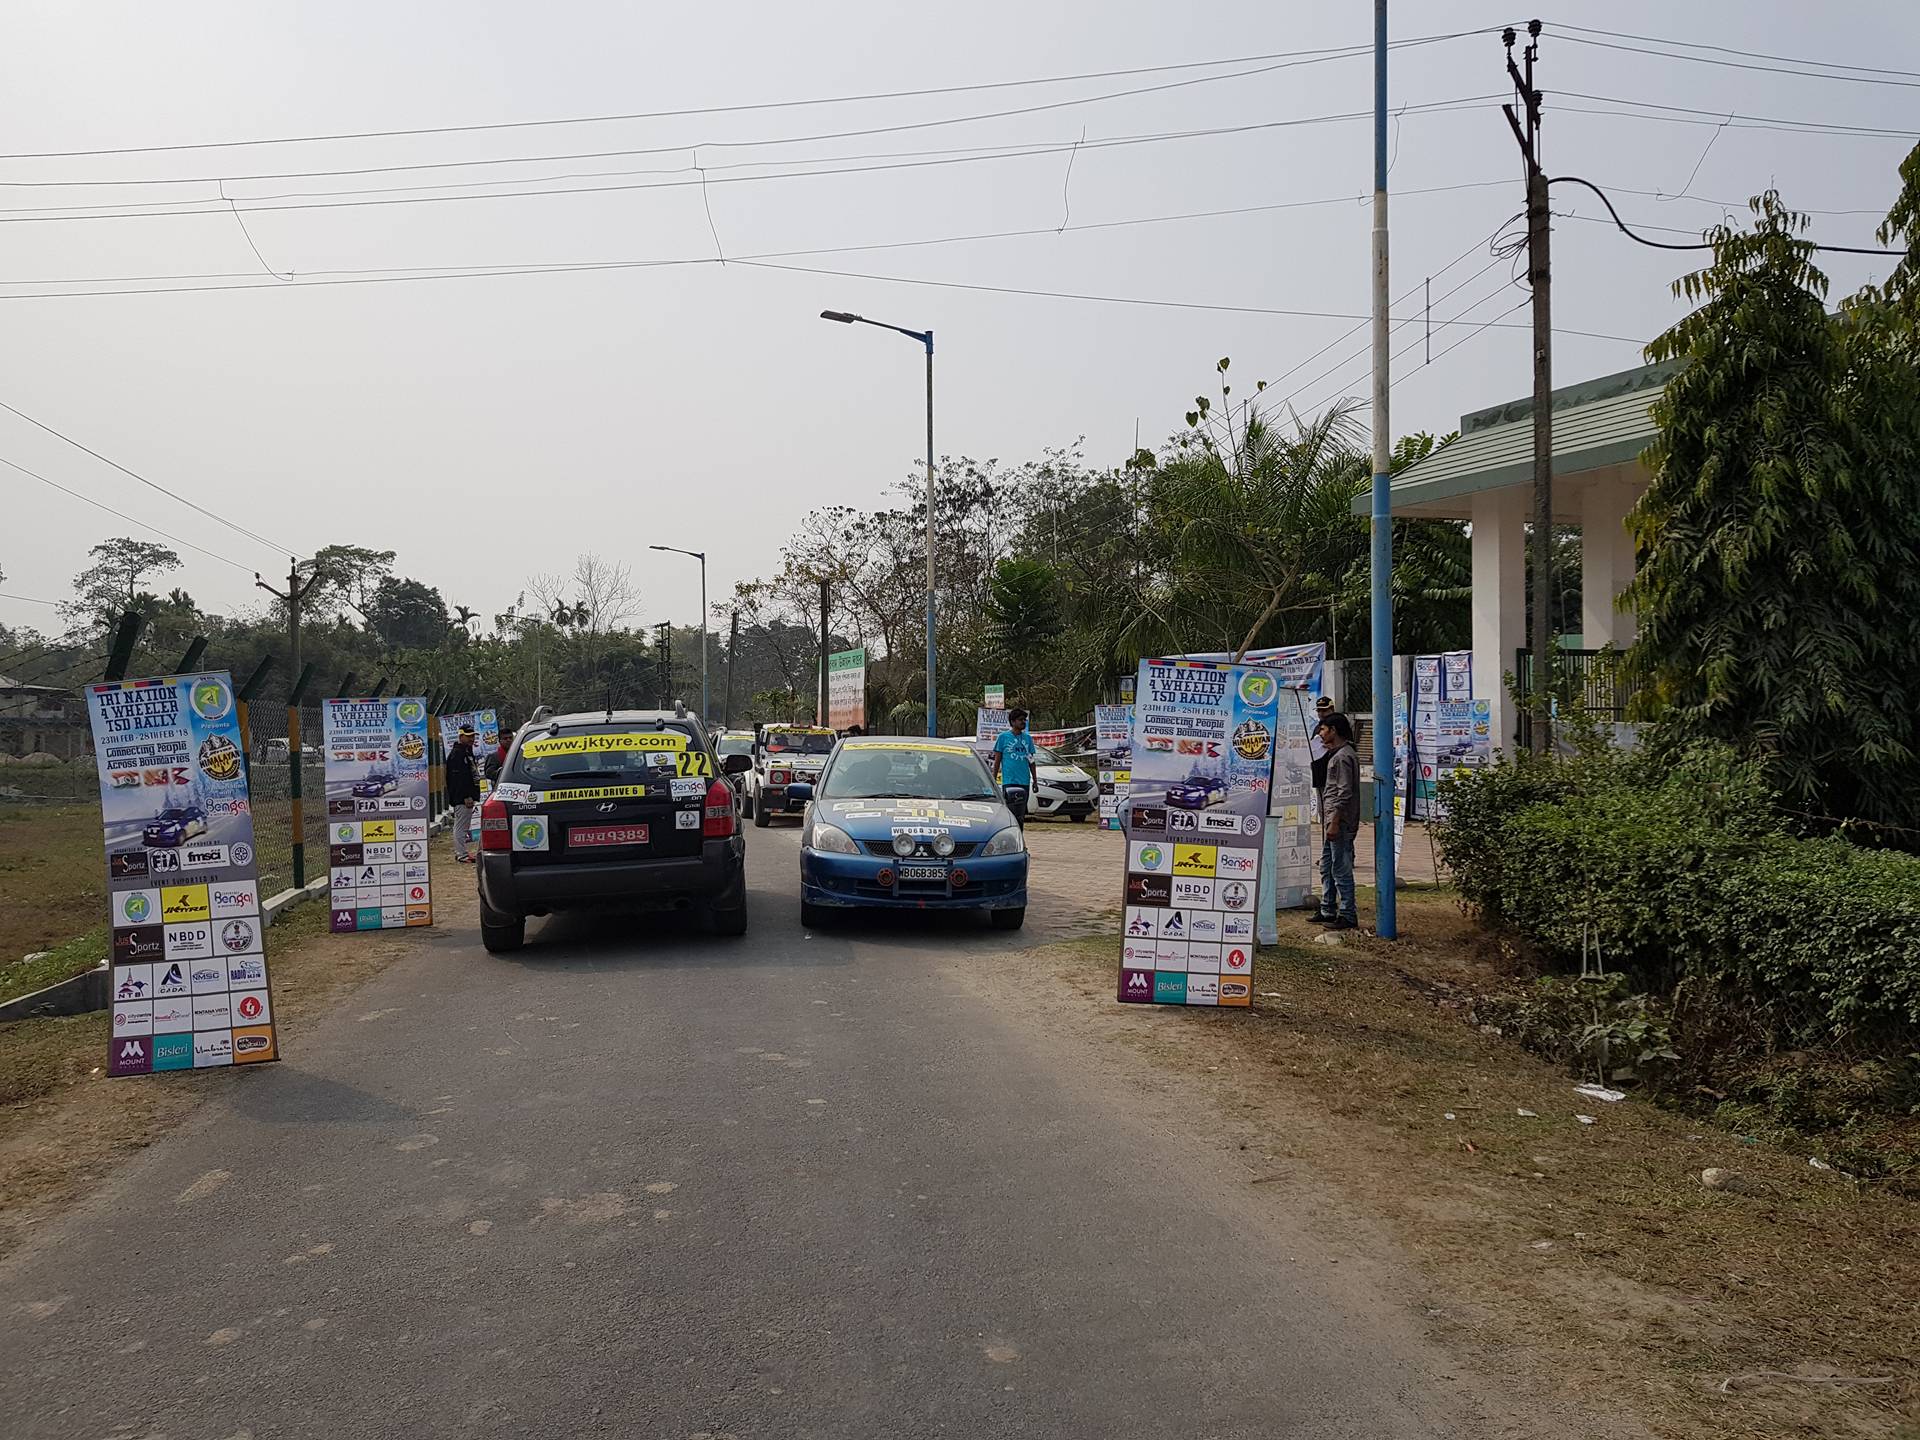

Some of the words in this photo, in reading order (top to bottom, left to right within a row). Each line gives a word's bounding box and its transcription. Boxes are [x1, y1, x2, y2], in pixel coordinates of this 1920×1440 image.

[1150, 667, 1172, 679] TRI
[1176, 669, 1229, 683] NATION
[1161, 680, 1225, 694] WHEELER
[97, 693, 120, 706] TRI
[123, 687, 178, 704] NATION
[1152, 691, 1176, 703] TSD
[1179, 692, 1222, 705] RALLY
[111, 700, 179, 718] WHEELER
[351, 703, 388, 712] NATION
[1202, 708, 1215, 716] FEB
[106, 719, 130, 732] TSD
[133, 713, 177, 730] RALLY
[340, 712, 388, 720] WHEELER
[355, 719, 386, 728] RALLY
[1146, 714, 1194, 728] Connecting
[1196, 718, 1225, 730] People
[120, 734, 134, 742] FEB
[159, 730, 174, 739] FEB
[1143, 725, 1174, 736] Across
[1176, 728, 1225, 739] Boundaries
[106, 744, 155, 758] Connecting
[156, 741, 187, 754] People
[535, 736, 676, 753] www.jktyre.com
[107, 757, 137, 770] Across
[139, 753, 190, 767] Boundaries
[679, 752, 709, 776] 22
[550, 788, 600, 800] HIMALAYAN
[603, 787, 629, 797] DRIVE
[632, 787, 638, 795] 6
[1221, 854, 1254, 871] Bengal
[1176, 883, 1210, 894] NBDD
[214, 891, 254, 908] Bengal
[120, 1058, 145, 1066] MOUNT
